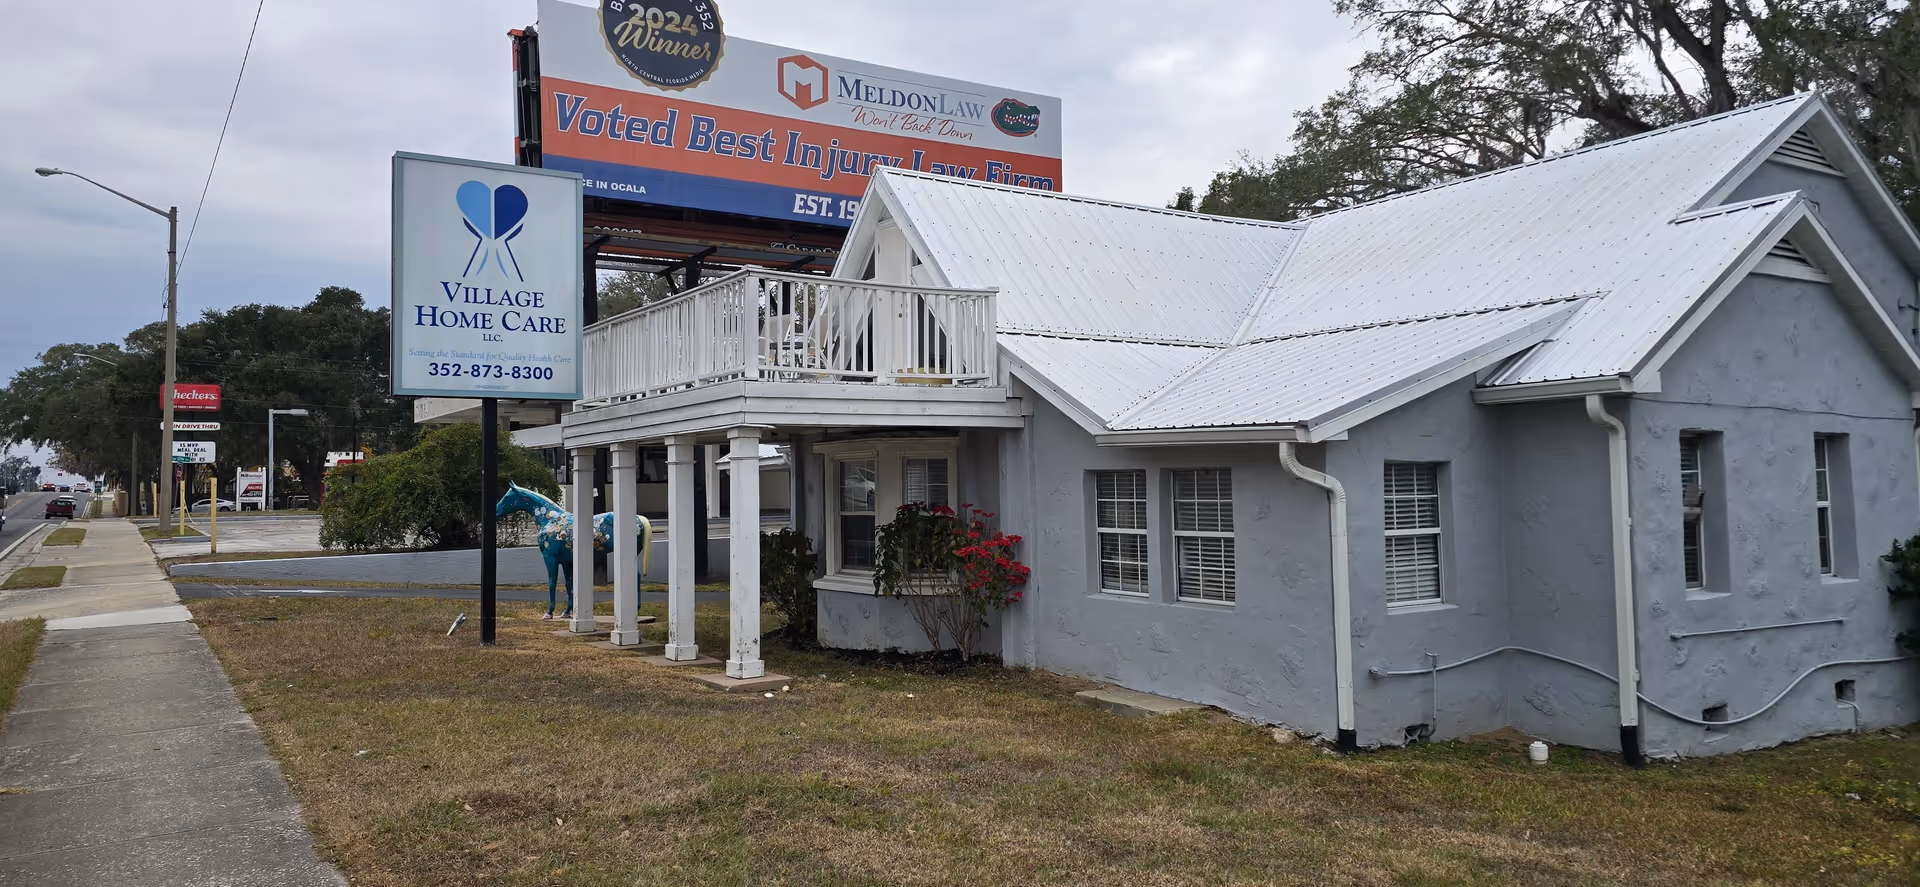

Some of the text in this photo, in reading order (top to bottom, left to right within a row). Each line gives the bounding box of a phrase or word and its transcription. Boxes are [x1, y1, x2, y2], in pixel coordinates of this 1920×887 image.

[628, 3, 698, 36] 2024
[695, 2, 714, 30] 352
[613, 21, 711, 61] Winner
[621, 53, 704, 84] NORTH CENTRAL FLORIDA MEDIA
[850, 104, 973, 141] Won't Back Down
[553, 92, 678, 148] Voted
[685, 113, 776, 163] Best
[782, 130, 904, 181] Injury
[985, 160, 1054, 192] Firm
[596, 180, 608, 190] IN
[610, 182, 647, 195] OCALA
[792, 193, 861, 220] EST. 19
[440, 281, 545, 308] VILLAGE
[414, 305, 567, 334] HOME CARE
[482, 334, 503, 342] LLC.
[408, 348, 571, 364] Setting the Standard for Quality Health Care
[428, 362, 553, 380] 352-873-8300
[173, 389, 218, 400] heckers
